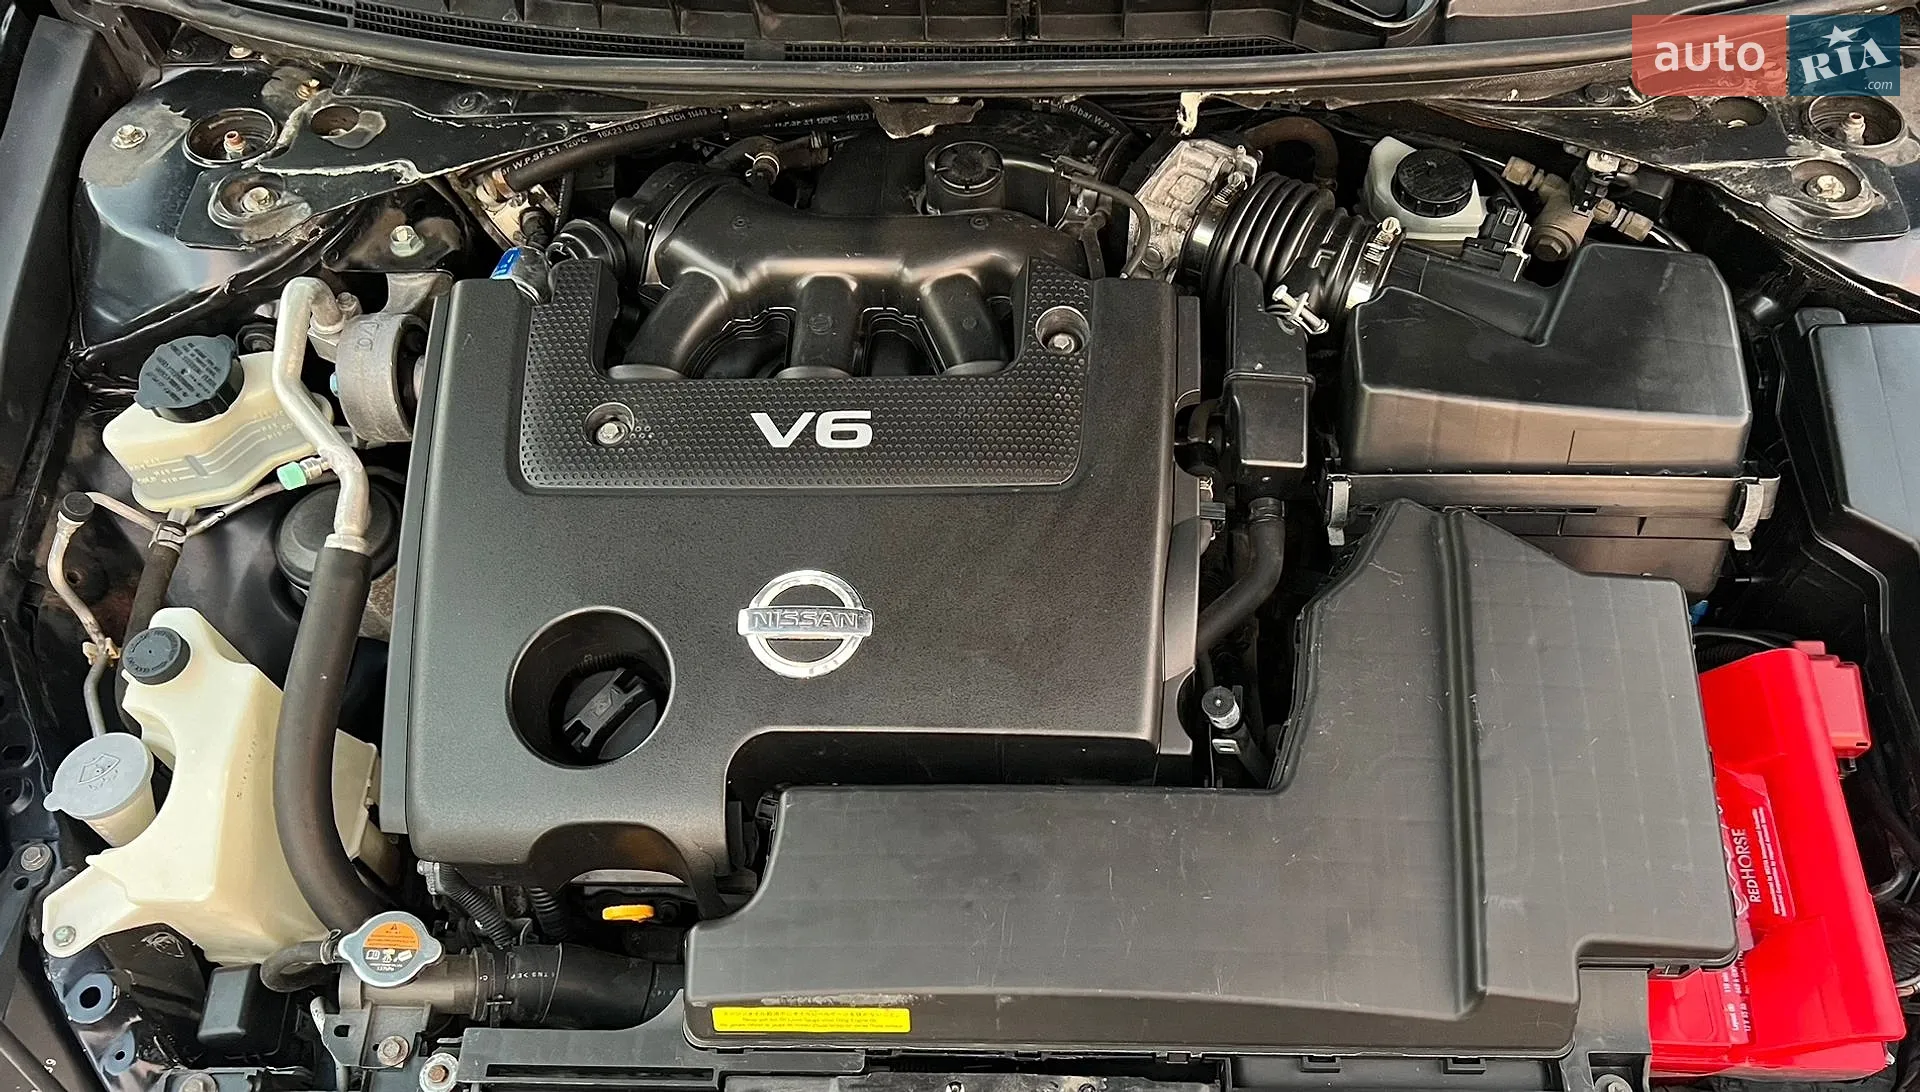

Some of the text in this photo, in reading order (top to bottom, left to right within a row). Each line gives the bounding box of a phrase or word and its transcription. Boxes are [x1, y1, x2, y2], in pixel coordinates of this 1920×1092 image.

[625, 122, 640, 133] ISO
[658, 112, 686, 126] BATCH
[750, 410, 873, 449] V6
[754, 610, 858, 629] NISSAN
[1730, 828, 1762, 903] REDHORSE
